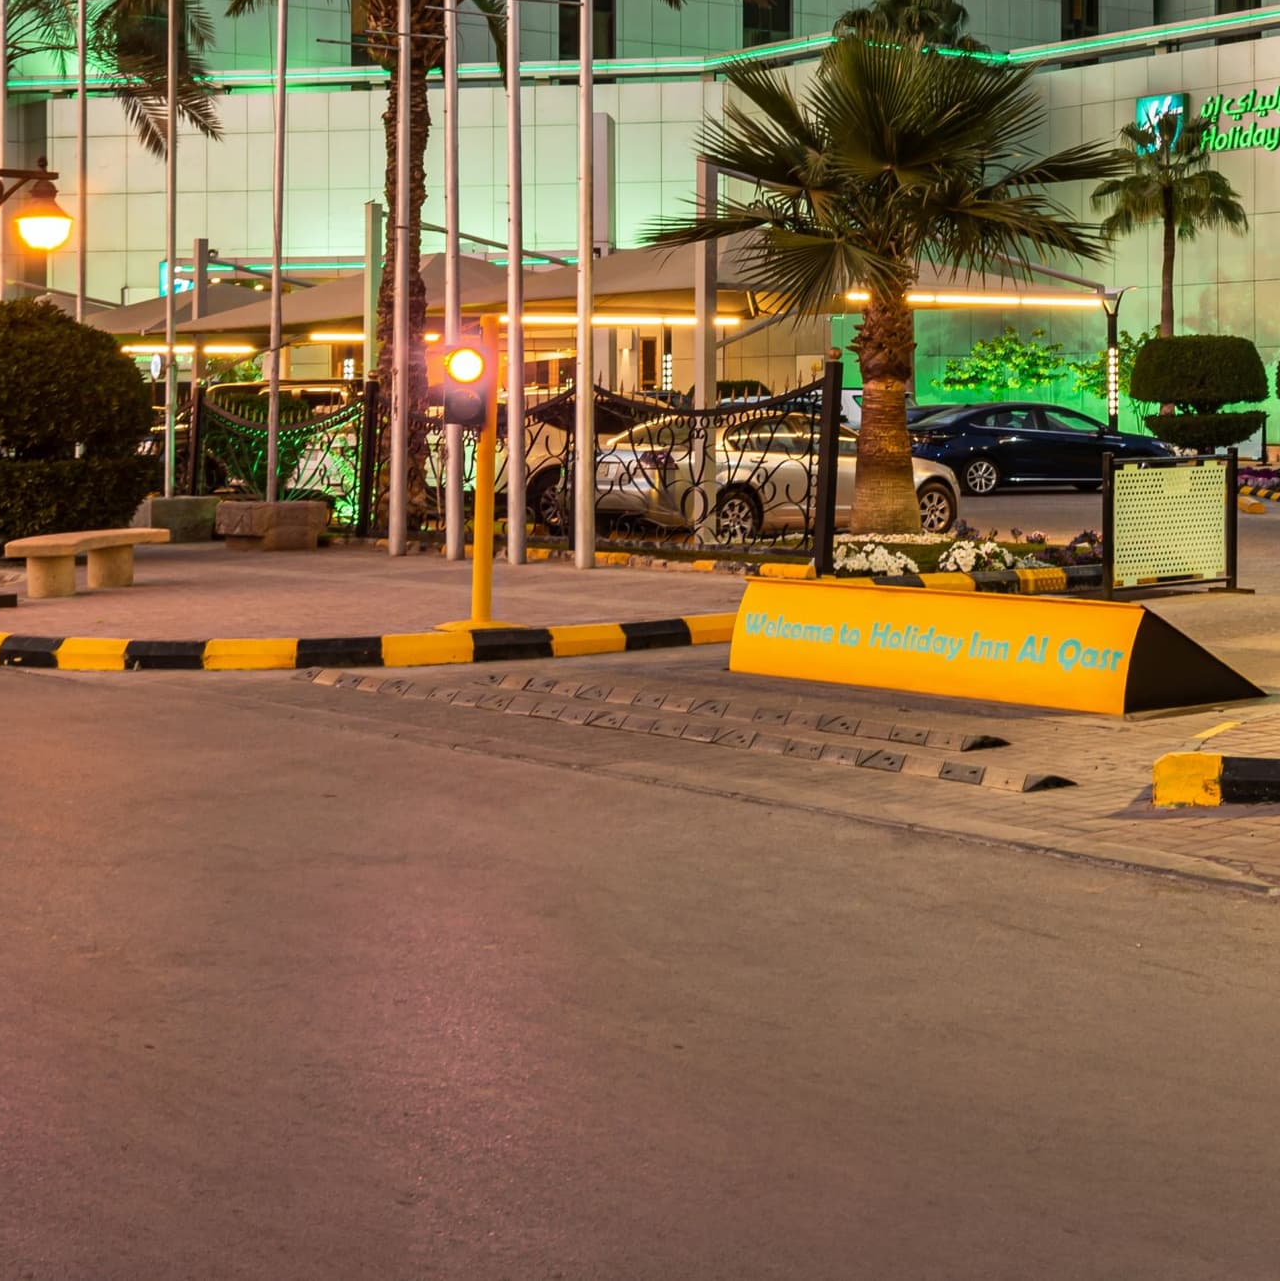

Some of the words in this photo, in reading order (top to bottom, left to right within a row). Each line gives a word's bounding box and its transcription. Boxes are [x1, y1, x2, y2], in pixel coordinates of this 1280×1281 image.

[745, 612, 834, 644] Welcome
[838, 622, 861, 647] to
[869, 621, 964, 661] Holiday
[968, 630, 1010, 661] Inn
[1016, 634, 1050, 664] Al
[1056, 638, 1125, 672] Qasr
